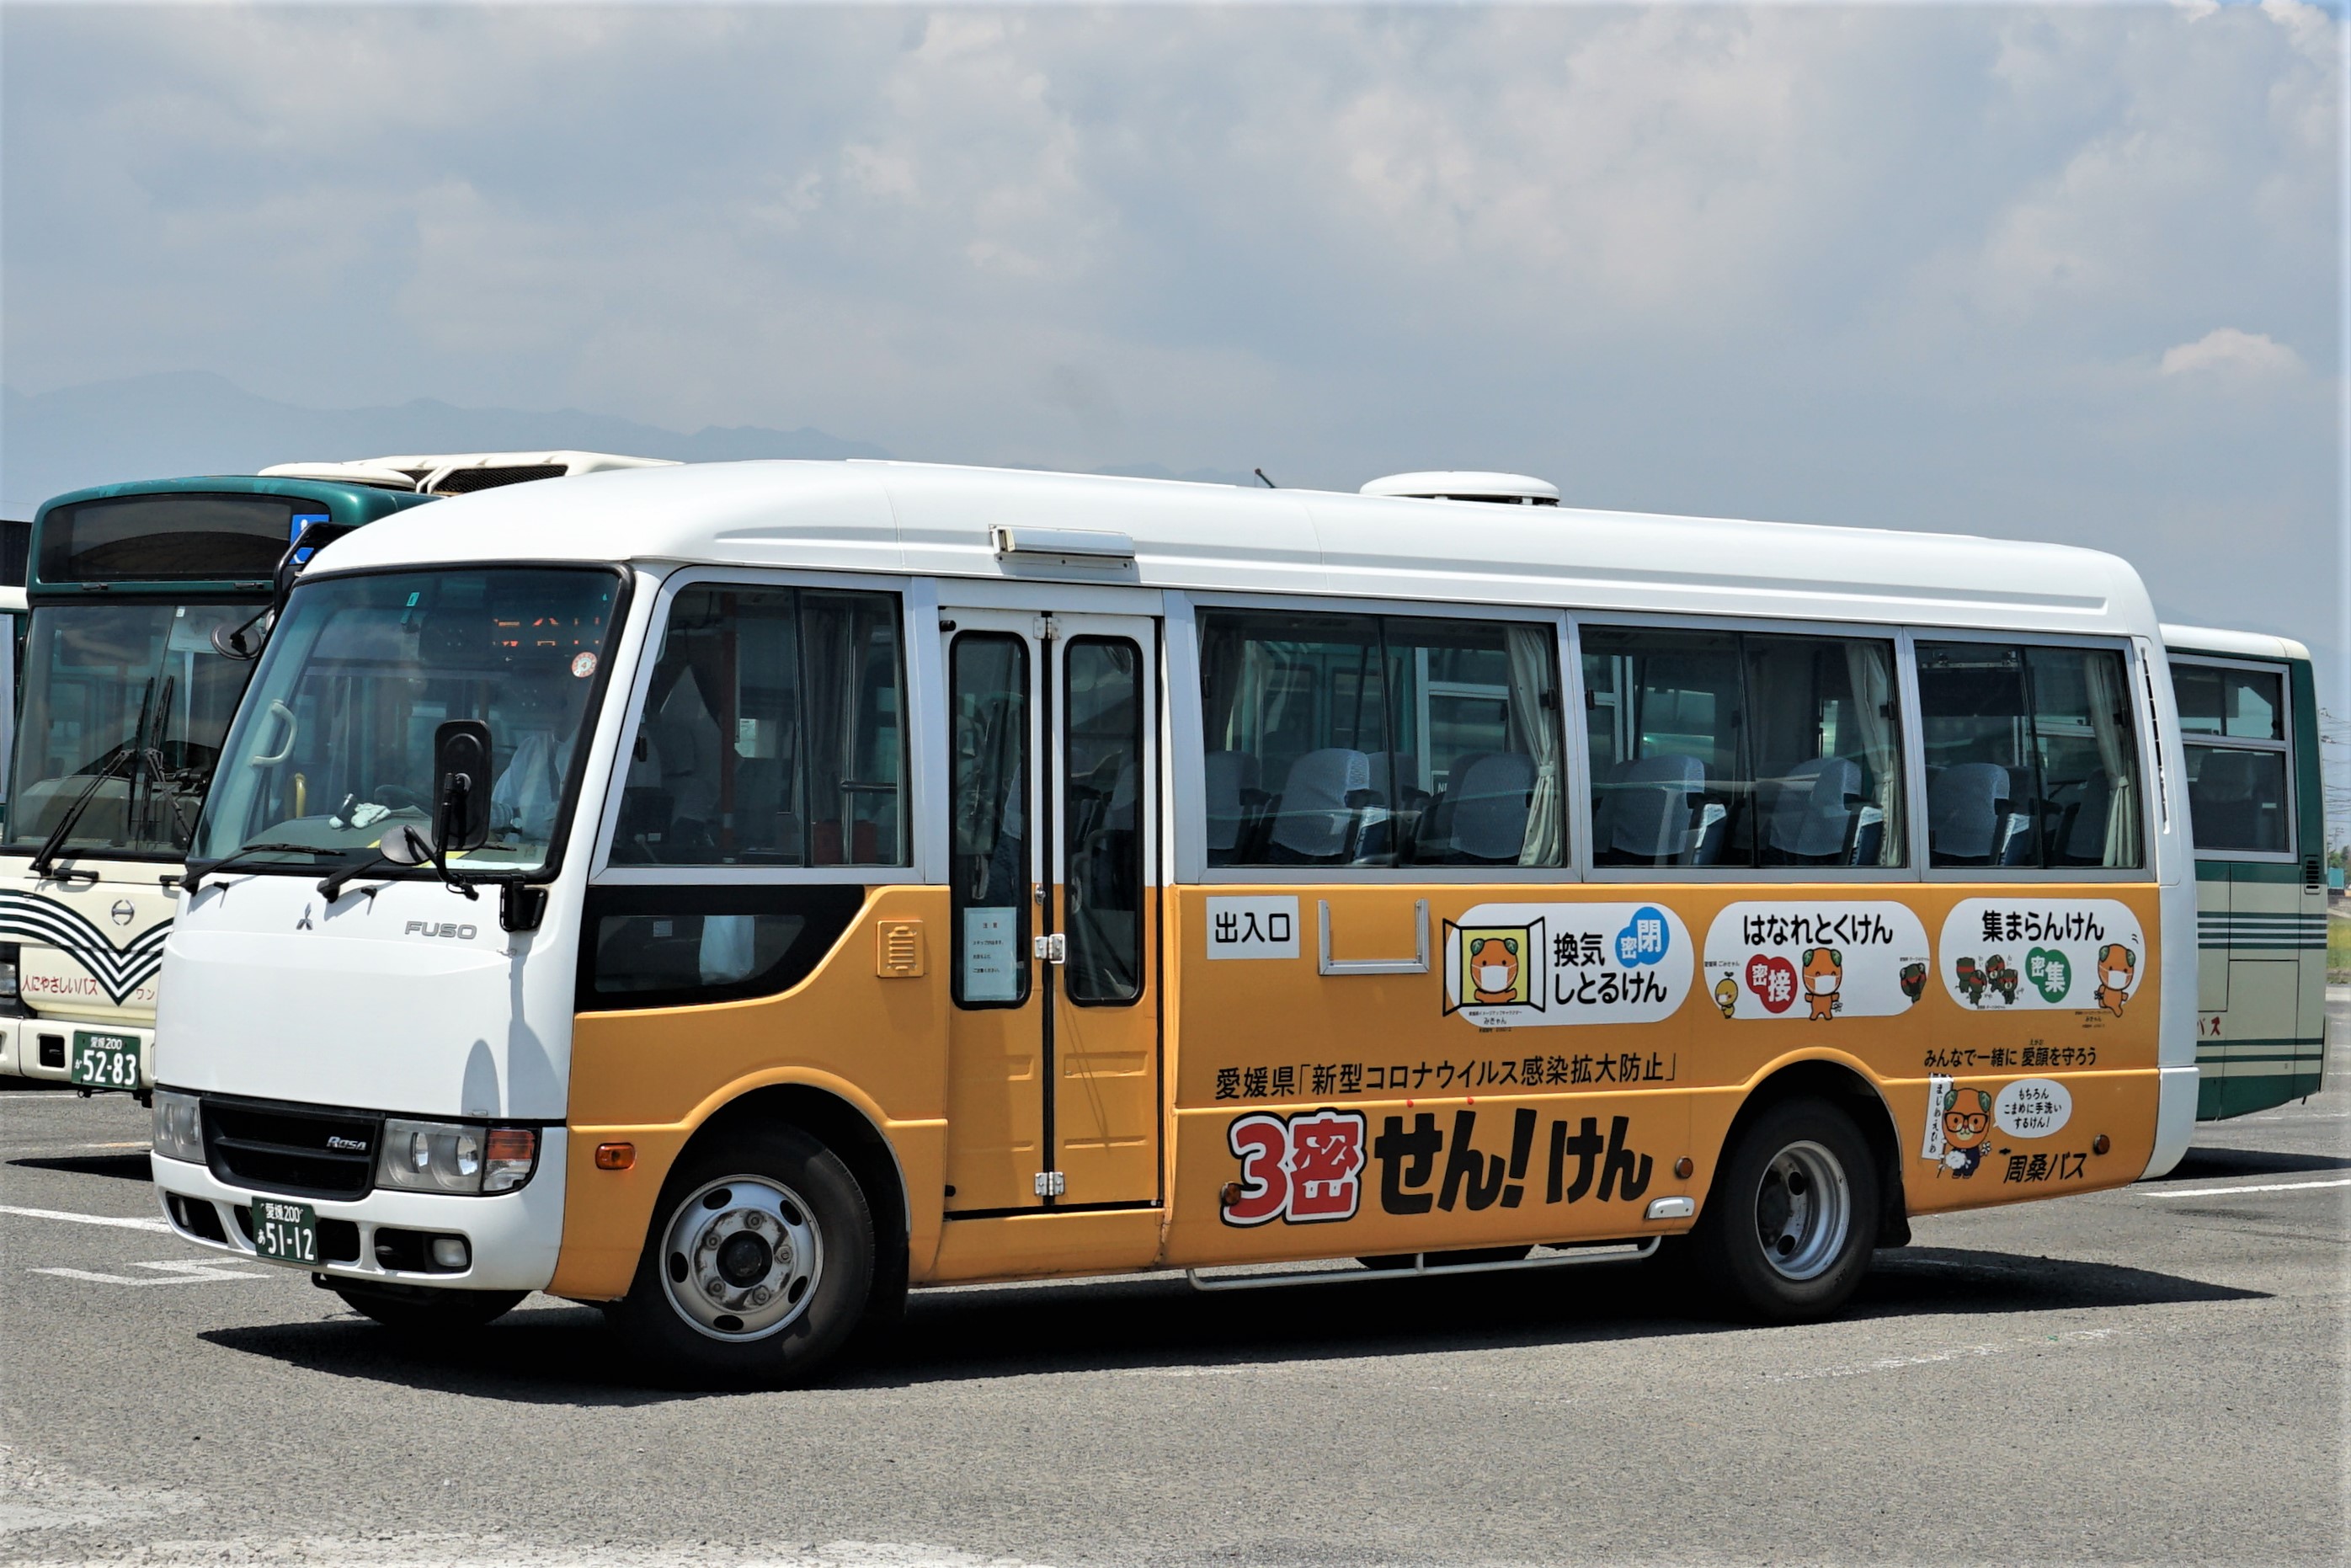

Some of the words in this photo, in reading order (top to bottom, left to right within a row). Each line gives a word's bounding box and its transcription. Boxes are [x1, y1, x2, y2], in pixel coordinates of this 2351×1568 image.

[404, 920, 477, 940] FUSO
[1215, 911, 1290, 943] 出入口
[1744, 913, 1893, 946] はなれとくけん
[1981, 909, 2104, 942] 集まらんけん
[1554, 931, 1605, 967] 換気
[22, 974, 98, 995] 人にやさしいバス
[1555, 971, 1667, 1005] しとるけん
[1751, 963, 1791, 1002] 密接
[2030, 955, 2066, 993] 密集
[83, 1049, 136, 1085] 52-83
[1924, 1048, 2018, 1068] みんなで一緒に
[2021, 1046, 2097, 1067] 愛顔を守ろう
[1215, 1052, 1678, 1101] 愛媛県「新型コロナウイルス感染拡大防止」
[2004, 1102, 2062, 1116] こまめに手洗い
[2018, 1087, 2050, 1101] もちろん
[2003, 1151, 2087, 1184] 周桑バス
[265, 1222, 314, 1261] 51-12
